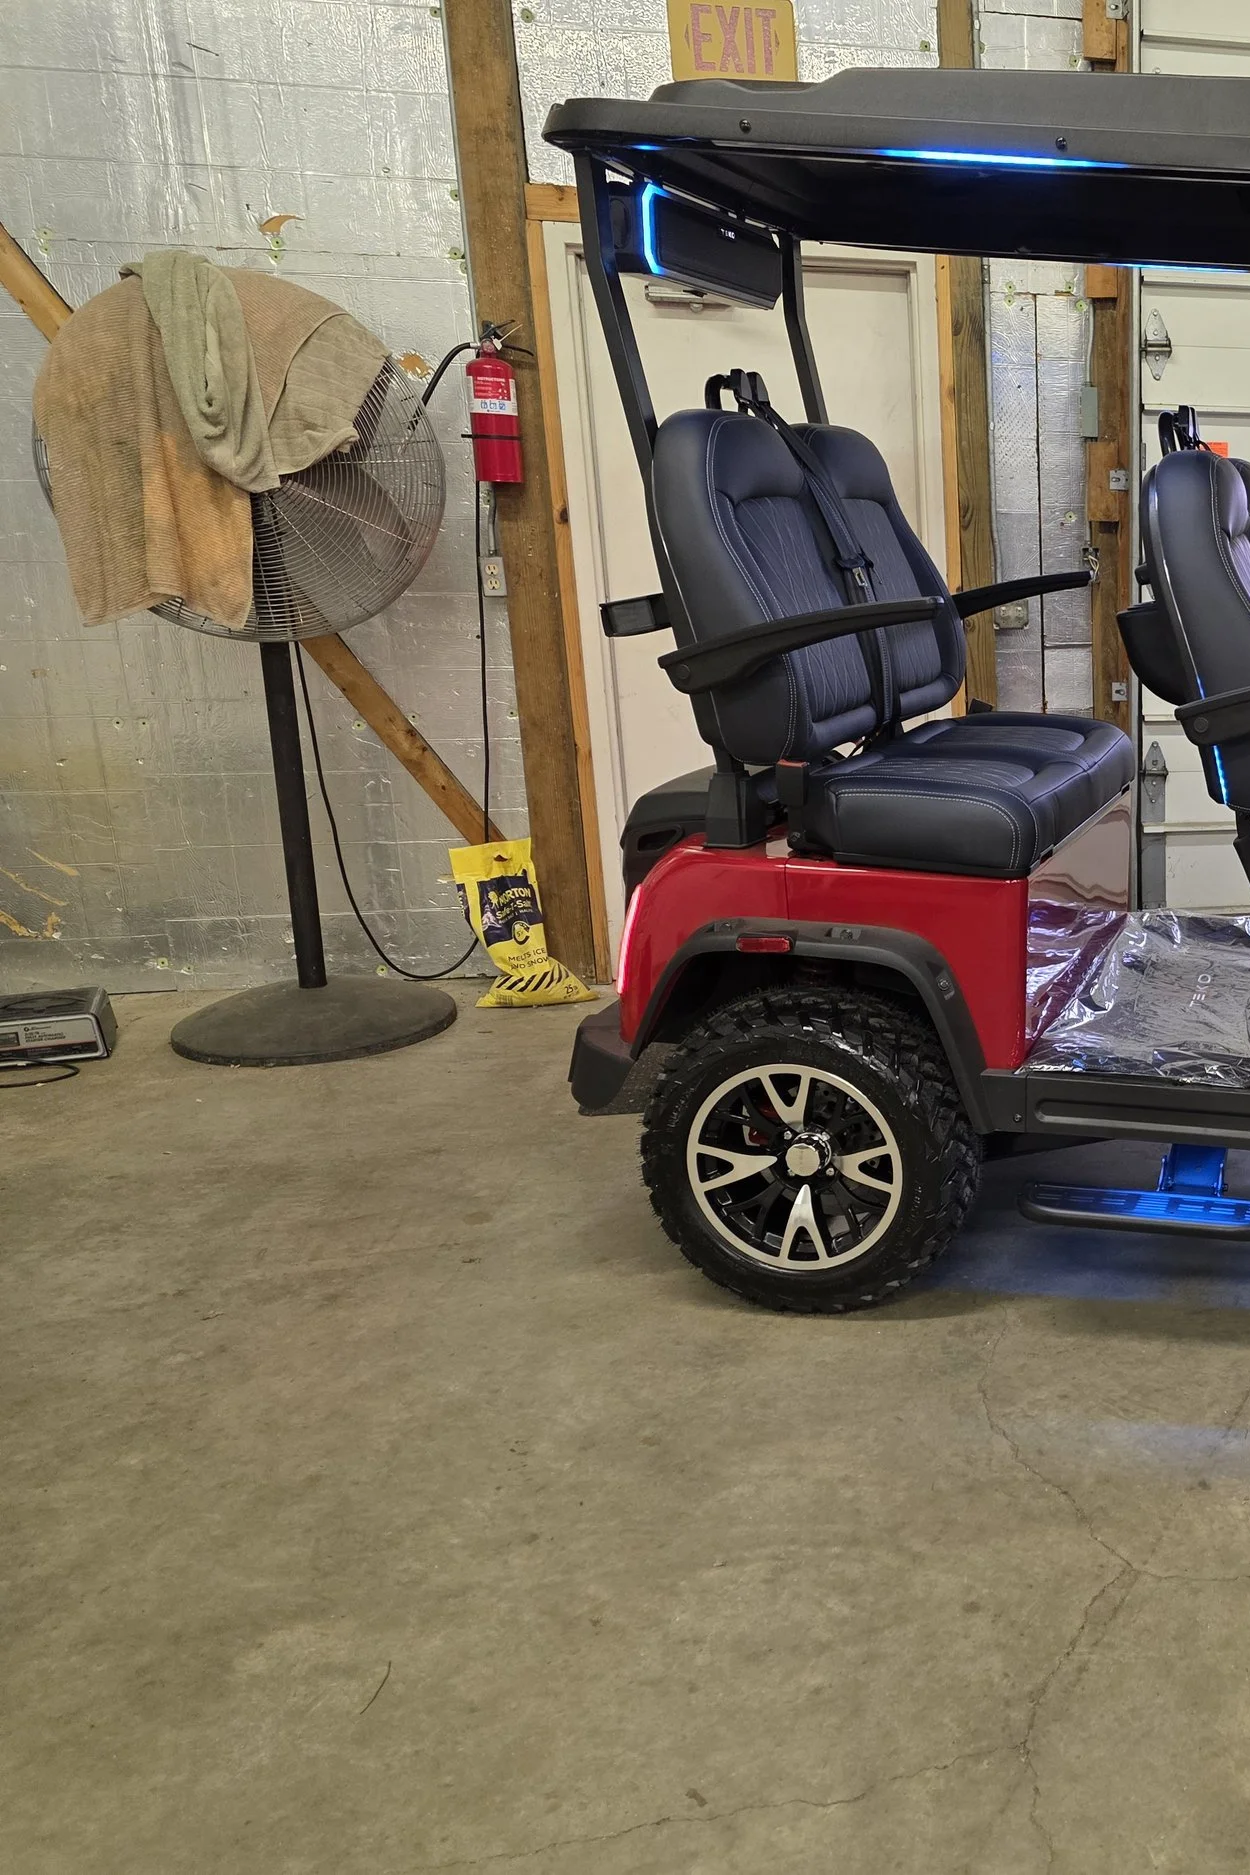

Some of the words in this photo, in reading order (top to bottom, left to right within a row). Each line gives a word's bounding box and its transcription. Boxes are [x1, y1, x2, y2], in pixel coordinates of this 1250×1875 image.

[690, 3, 776, 75] EXIT
[508, 952, 531, 962] MELTS
[532, 948, 546, 956] ICE
[564, 984, 574, 994] 25
[1189, 973, 1211, 1007] TEKO
